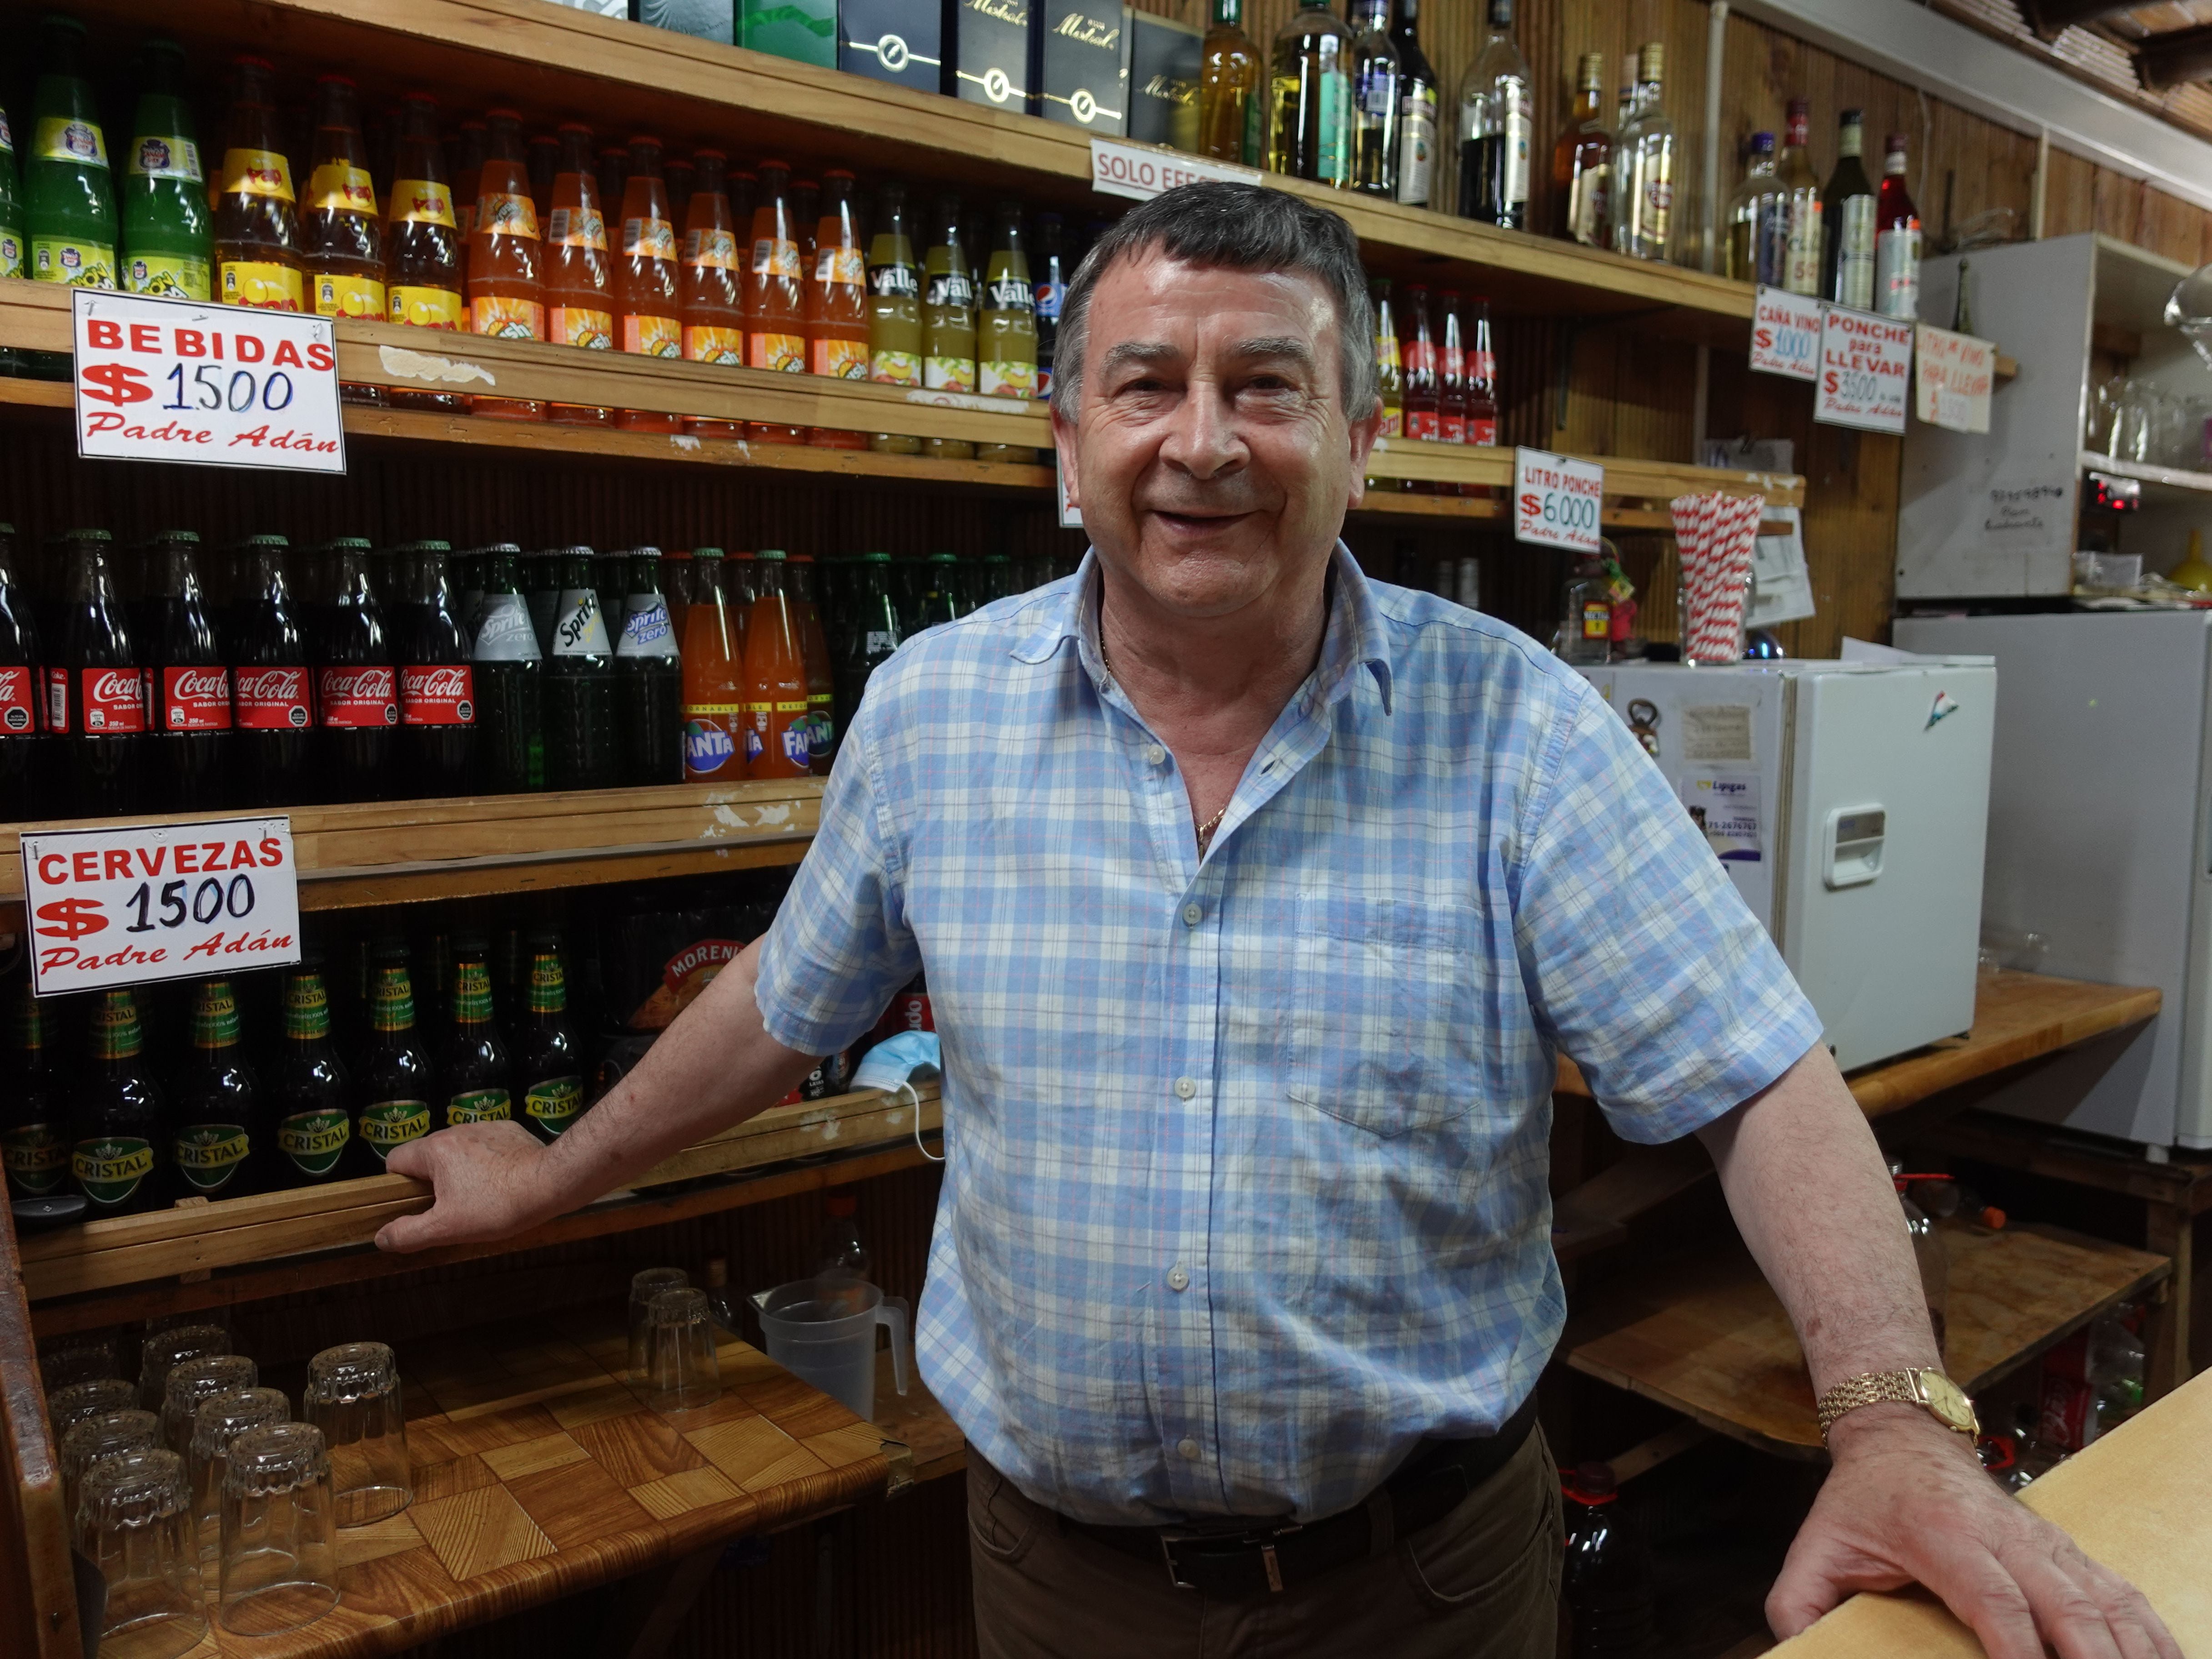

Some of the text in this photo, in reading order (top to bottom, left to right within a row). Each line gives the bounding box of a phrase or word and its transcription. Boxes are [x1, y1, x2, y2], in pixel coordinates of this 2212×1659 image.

[1098, 153, 1155, 186] SOLO
[870, 268, 918, 292] Valle
[935, 276, 973, 300] Vall
[990, 282, 1036, 307] Valle
[1828, 314, 1909, 345] PONCHE
[87, 319, 336, 372] BEBIDAS
[1849, 337, 1882, 355] para
[1825, 348, 1905, 377] LLEVAR
[80, 363, 293, 412] $ 1500
[86, 412, 338, 453] Padre Adán
[1525, 466, 1601, 498] LITRO PONCHE
[1520, 492, 1594, 529] $ 6000
[483, 610, 528, 638] Sprite
[560, 594, 600, 647] Sprite
[627, 604, 667, 633] Sprite
[638, 625, 667, 645] zero
[321, 669, 392, 698] Coca-Cola
[401, 667, 467, 697] Coca-Cola
[38, 838, 283, 885] CERVEZAS
[35, 874, 255, 941] $ 1500
[40, 929, 295, 975] Padre Adán
[671, 945, 740, 977] MORENI
[283, 1126, 342, 1152] CRISTAL
[364, 1117, 426, 1140] CRISTAL
[75, 1155, 147, 1178] CRISTAL
